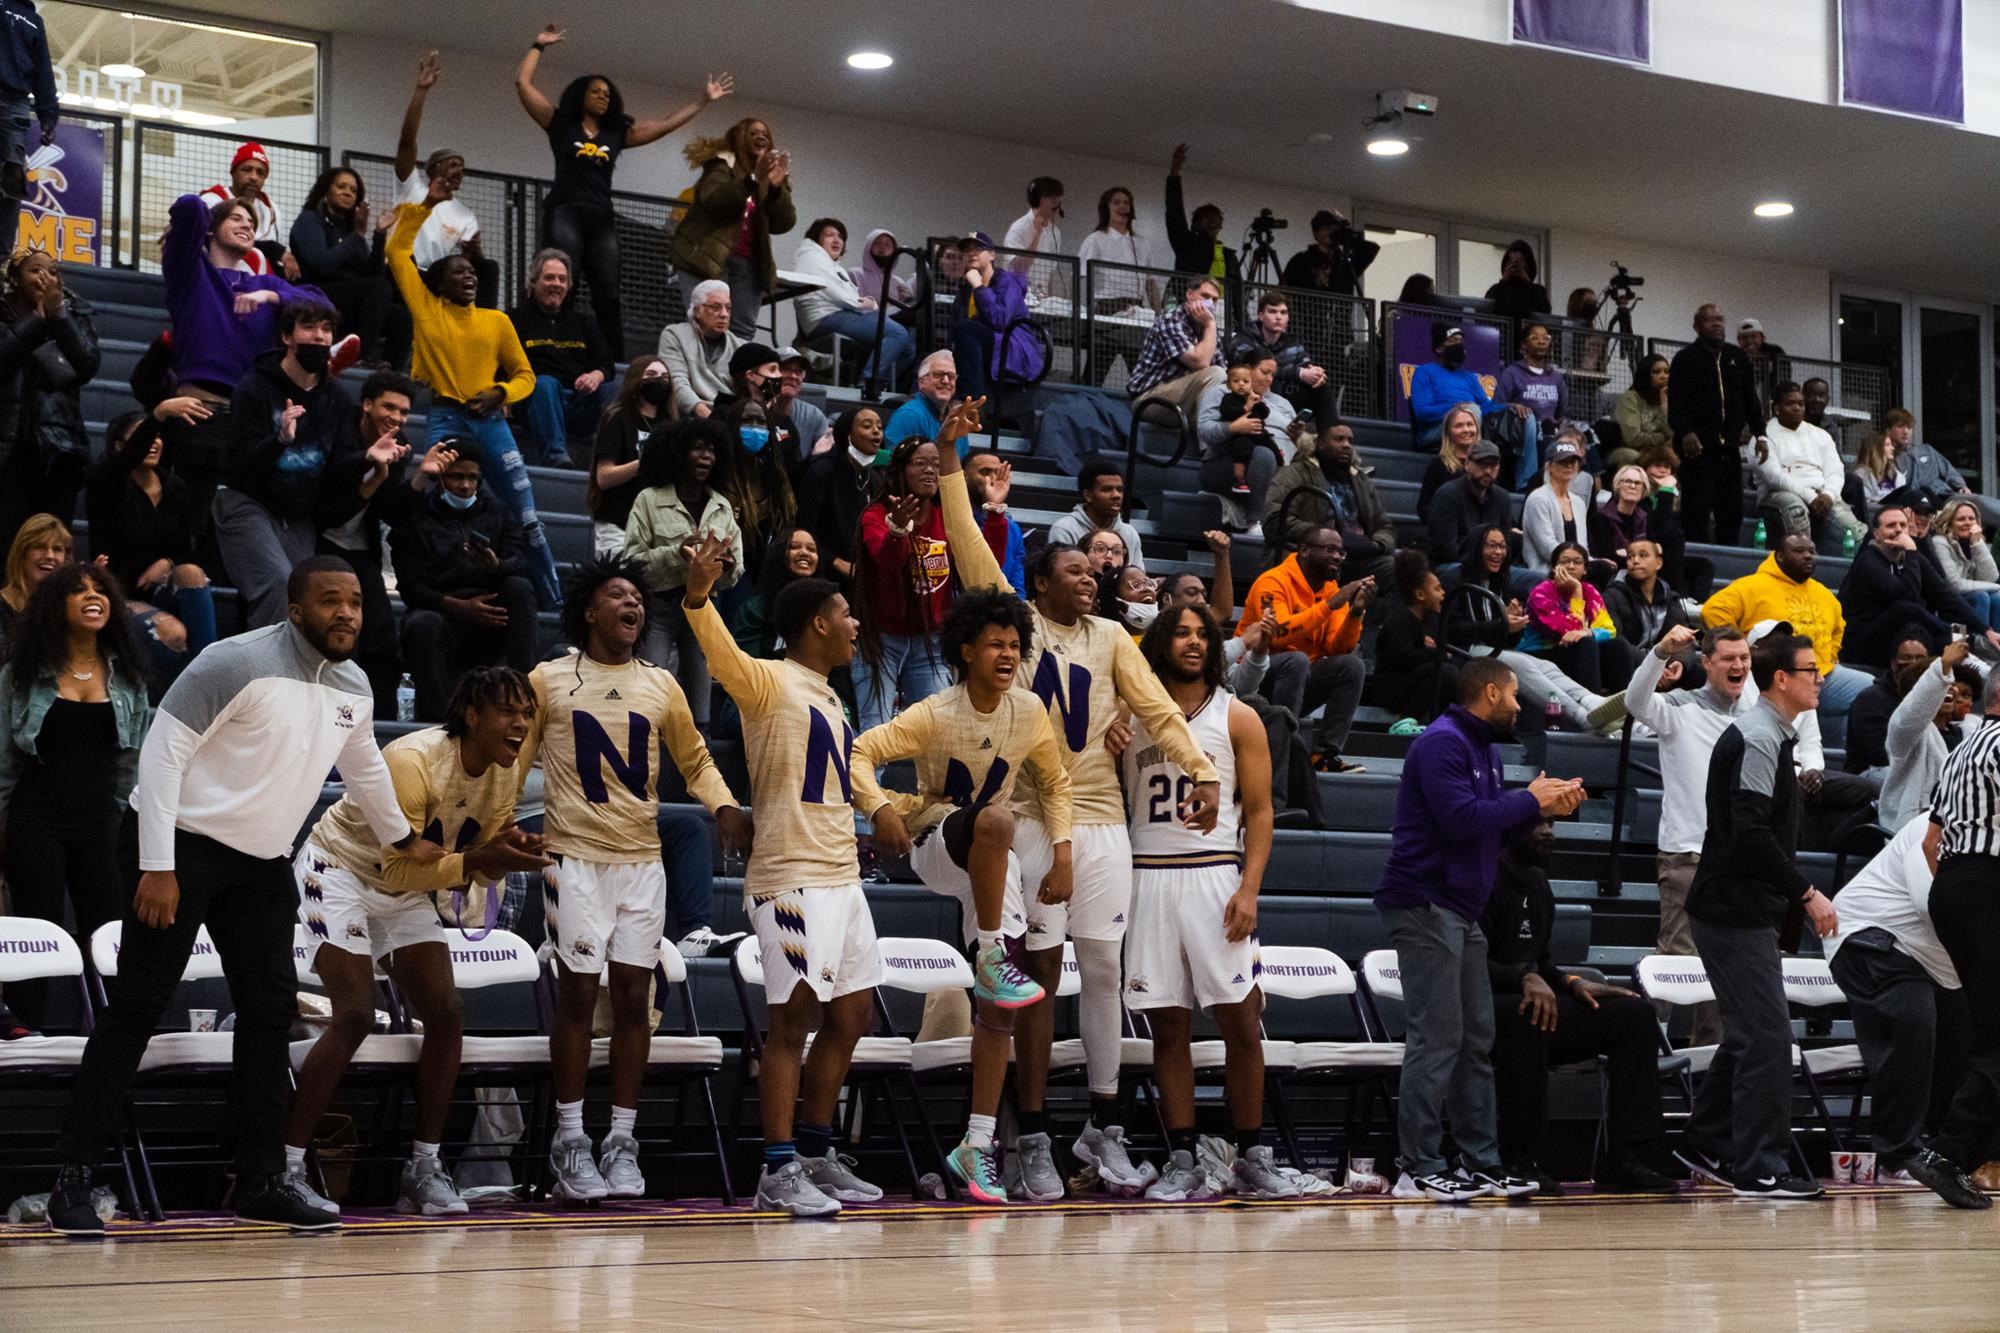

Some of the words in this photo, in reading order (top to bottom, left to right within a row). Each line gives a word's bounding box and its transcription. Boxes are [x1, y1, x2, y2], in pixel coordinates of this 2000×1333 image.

[1031, 648, 1092, 753] N
[572, 710, 651, 804] N
[801, 704, 854, 804] N
[450, 948, 518, 963] THTOWN
[885, 957, 957, 970] NORTHTOWN
[1261, 964, 1338, 977] NORTHTOWN
[1782, 975, 1836, 986] NORTHTOW
